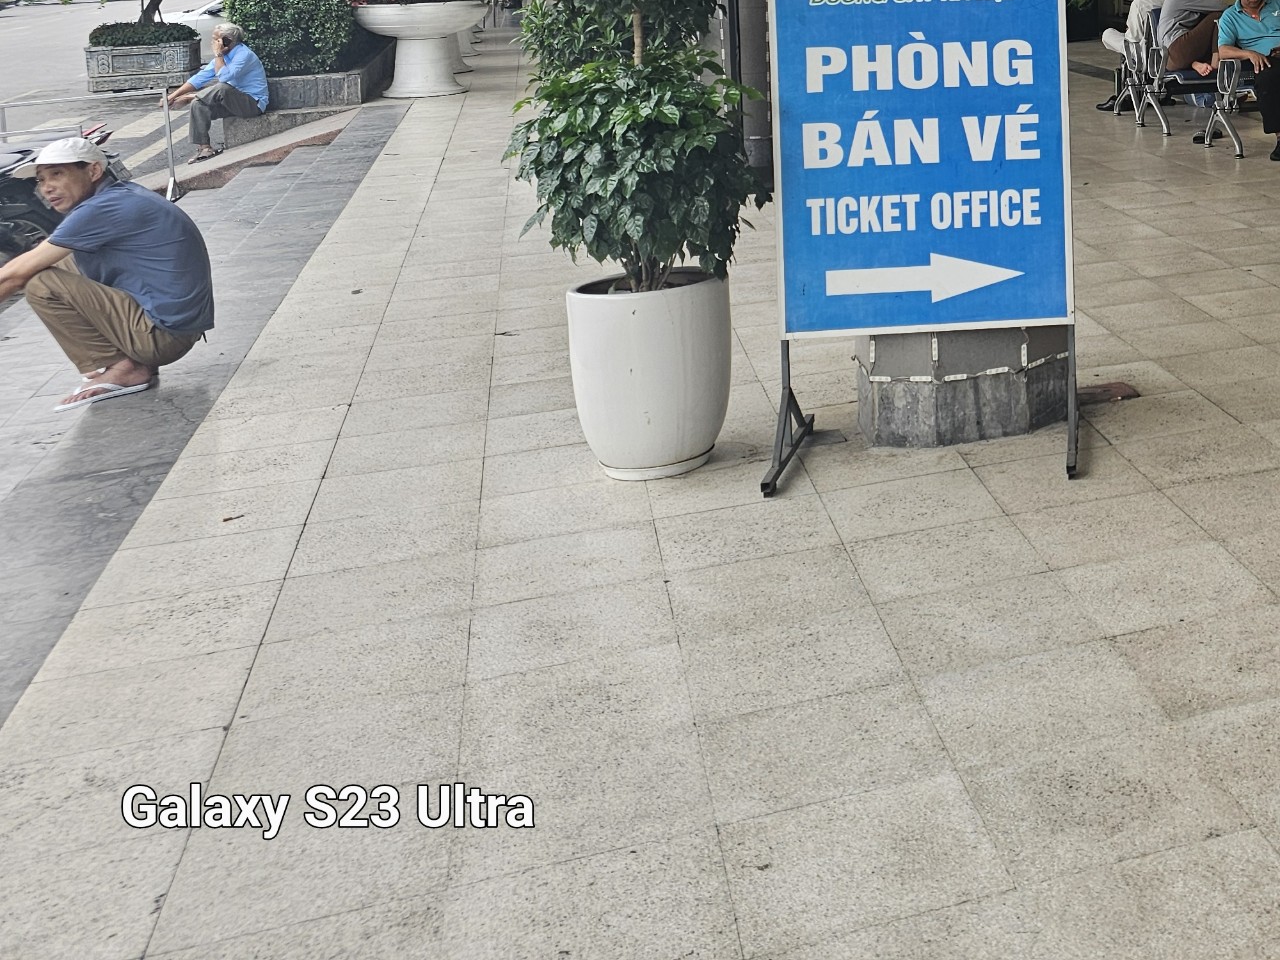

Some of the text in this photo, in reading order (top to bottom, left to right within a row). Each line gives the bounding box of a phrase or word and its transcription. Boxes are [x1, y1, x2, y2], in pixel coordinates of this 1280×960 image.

[805, 31, 1034, 94] PHÒNG
[801, 103, 1040, 169] BÁN VÉ
[806, 188, 1042, 236] TICKET OFFICE
